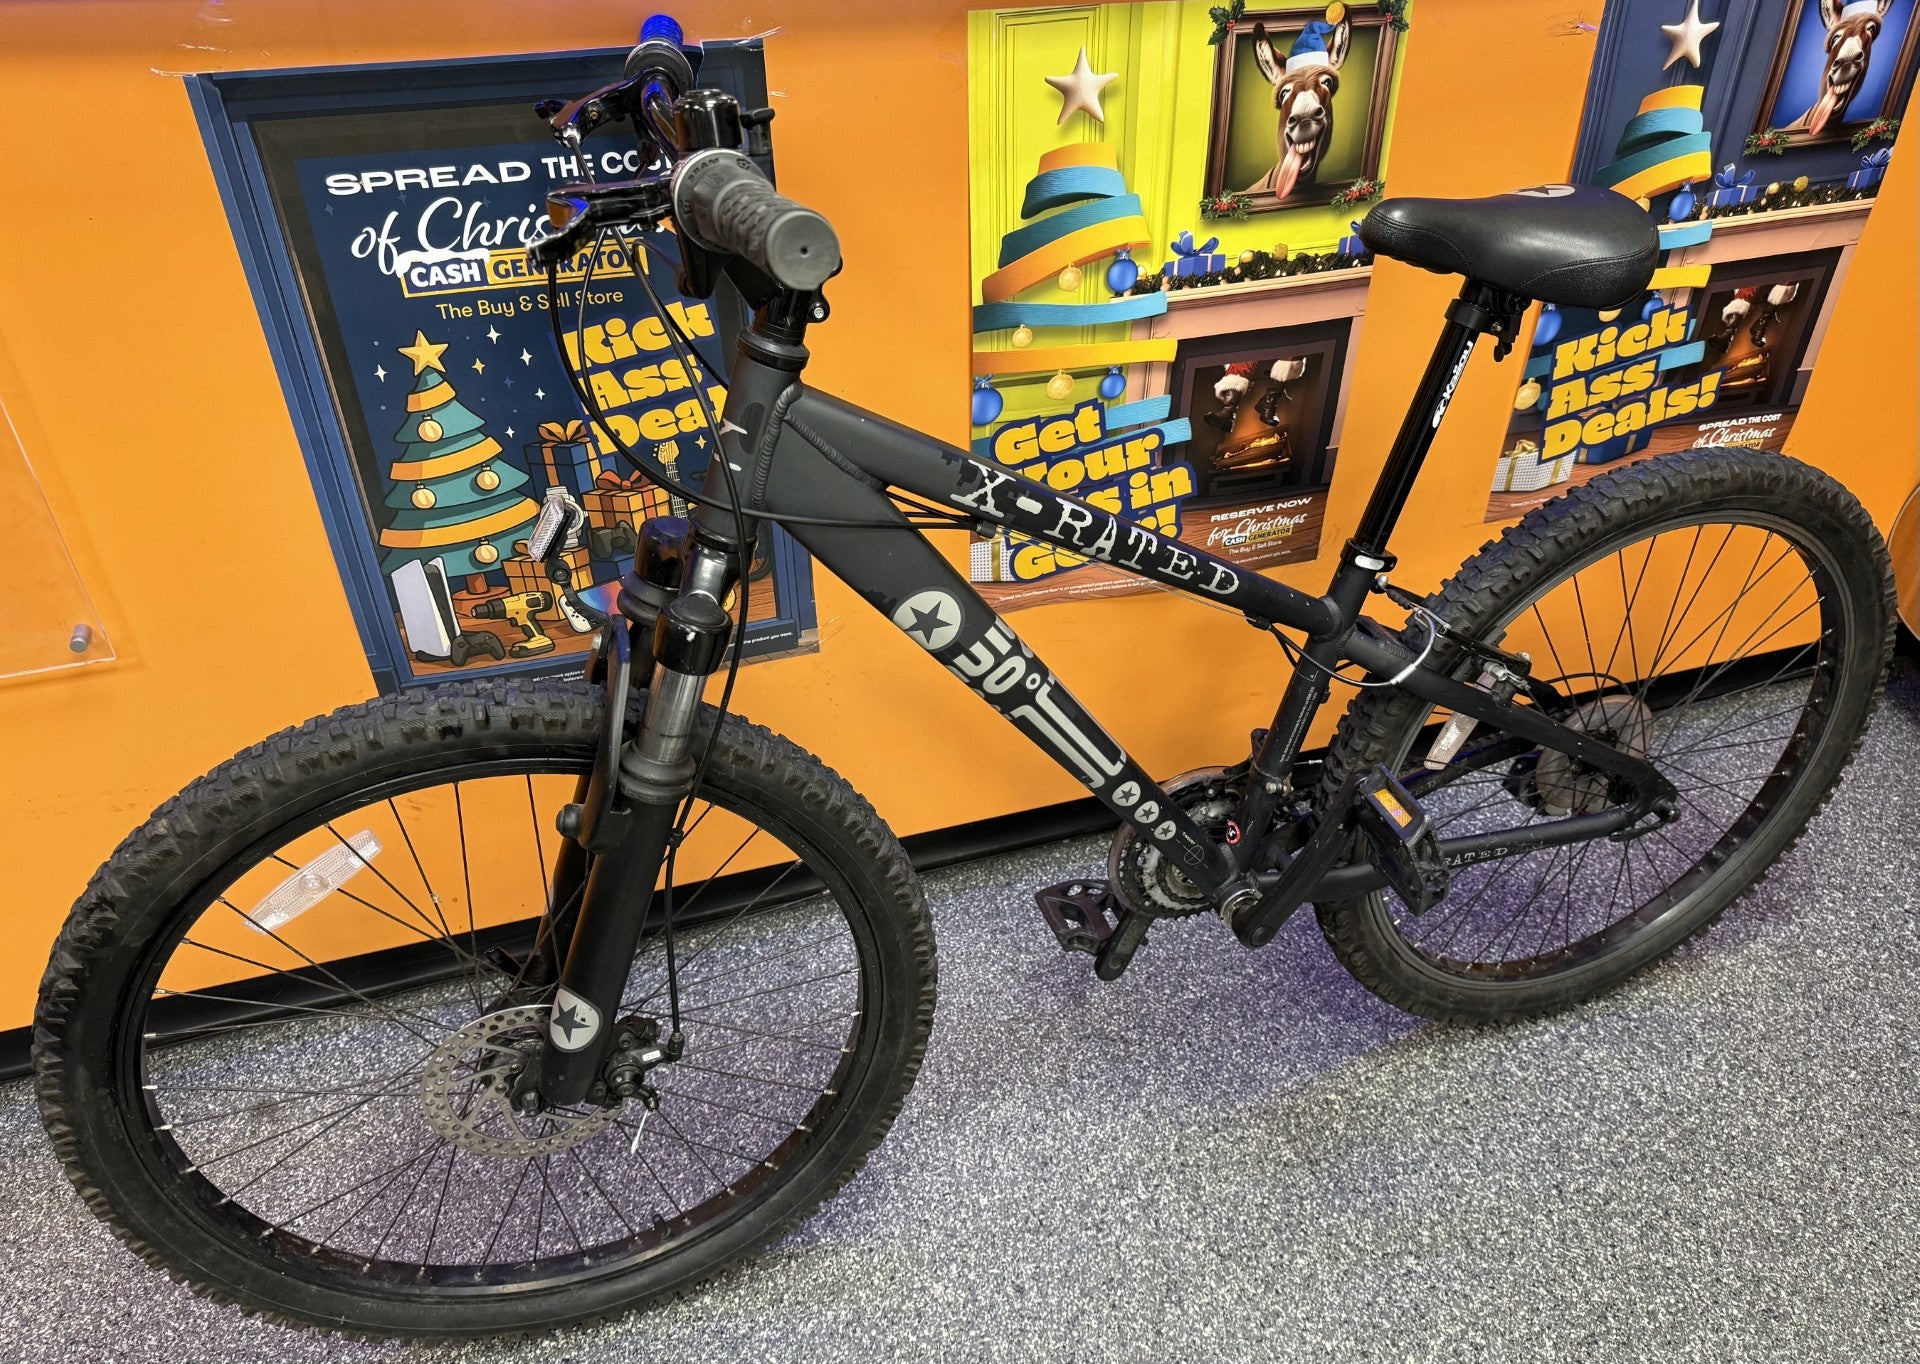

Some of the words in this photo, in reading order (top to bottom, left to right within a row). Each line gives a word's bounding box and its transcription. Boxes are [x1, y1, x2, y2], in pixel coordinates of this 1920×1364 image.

[325, 161, 532, 196] SPREAD
[541, 154, 596, 179] THE
[350, 210, 401, 275] of
[410, 259, 481, 288] CASH
[435, 301, 473, 320] The
[478, 298, 514, 318] Buy
[520, 294, 533, 311] &
[563, 301, 715, 371] Kick
[1552, 309, 1688, 380] Kick
[578, 354, 703, 416] Ass
[1546, 359, 1657, 421] Ass
[994, 405, 1102, 465] Get
[1541, 371, 1722, 460] Deals!
[1698, 417, 1748, 431] SPREAD
[1748, 415, 1761, 424] THE
[1762, 413, 1782, 422] COST
[1709, 427, 1777, 445] Christmas
[1129, 466, 1192, 509] in
[950, 459, 1240, 595] X-RATED
[1206, 527, 1232, 547] for
[1233, 513, 1308, 537] Christmas
[1210, 504, 1275, 522] RESERVE
[1276, 497, 1313, 510] NOW
[1225, 535, 1246, 546] CASH
[1248, 527, 1291, 541] GENERATOR
